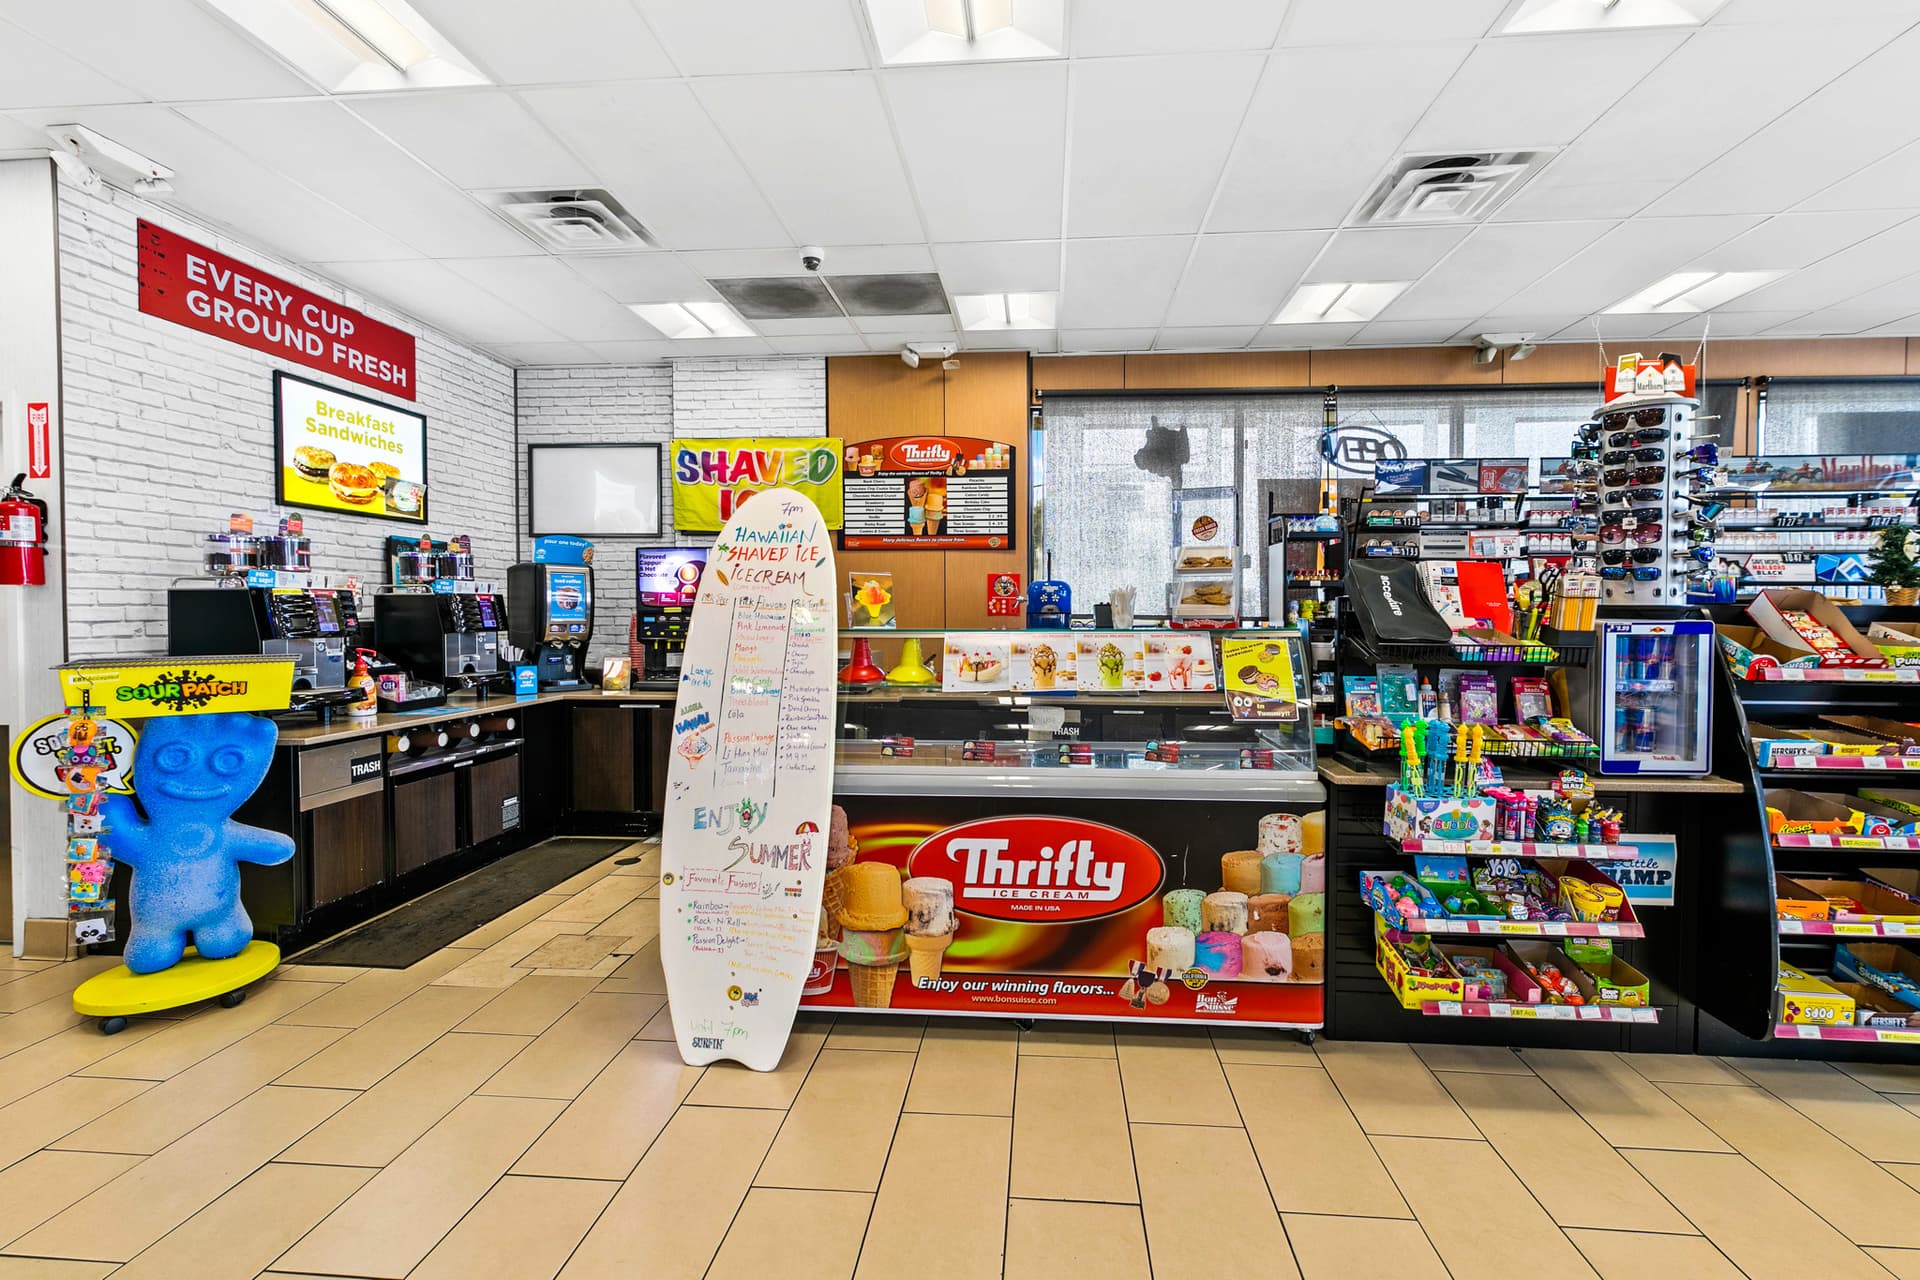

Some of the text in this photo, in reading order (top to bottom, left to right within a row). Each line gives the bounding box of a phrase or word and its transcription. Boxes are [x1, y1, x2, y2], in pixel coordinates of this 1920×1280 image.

[186, 253, 355, 338] EVERY CUP
[186, 290, 408, 388] GROUND FRESH
[316, 400, 395, 436] Breakfast
[305, 417, 404, 455] Sandwiches
[901, 444, 950, 462] Thrifty
[676, 448, 837, 486] SHAVED
[782, 502, 804, 516] 7pm
[735, 521, 818, 545] HAWAIIAN
[727, 546, 789, 562] SHAVED
[115, 680, 249, 702] SOUR PATCH
[727, 709, 745, 720] Cola
[1054, 727, 1080, 736] TRASH
[352, 760, 381, 777] TRASH
[693, 799, 768, 836] ENJOY
[1433, 818, 1477, 831] Bubble
[722, 836, 812, 872] SUMMER
[946, 838, 1126, 900] Thrifty
[992, 889, 1090, 900] ICE CREAM
[1010, 904, 1033, 912] MADE
[1034, 904, 1043, 912] IN
[918, 977, 1115, 996] Enjoy our winning flavors...
[1857, 966, 1895, 994] Skittles
[971, 995, 1057, 1006] www.bonsuisse.com
[1804, 1006, 1835, 1020] POPS
